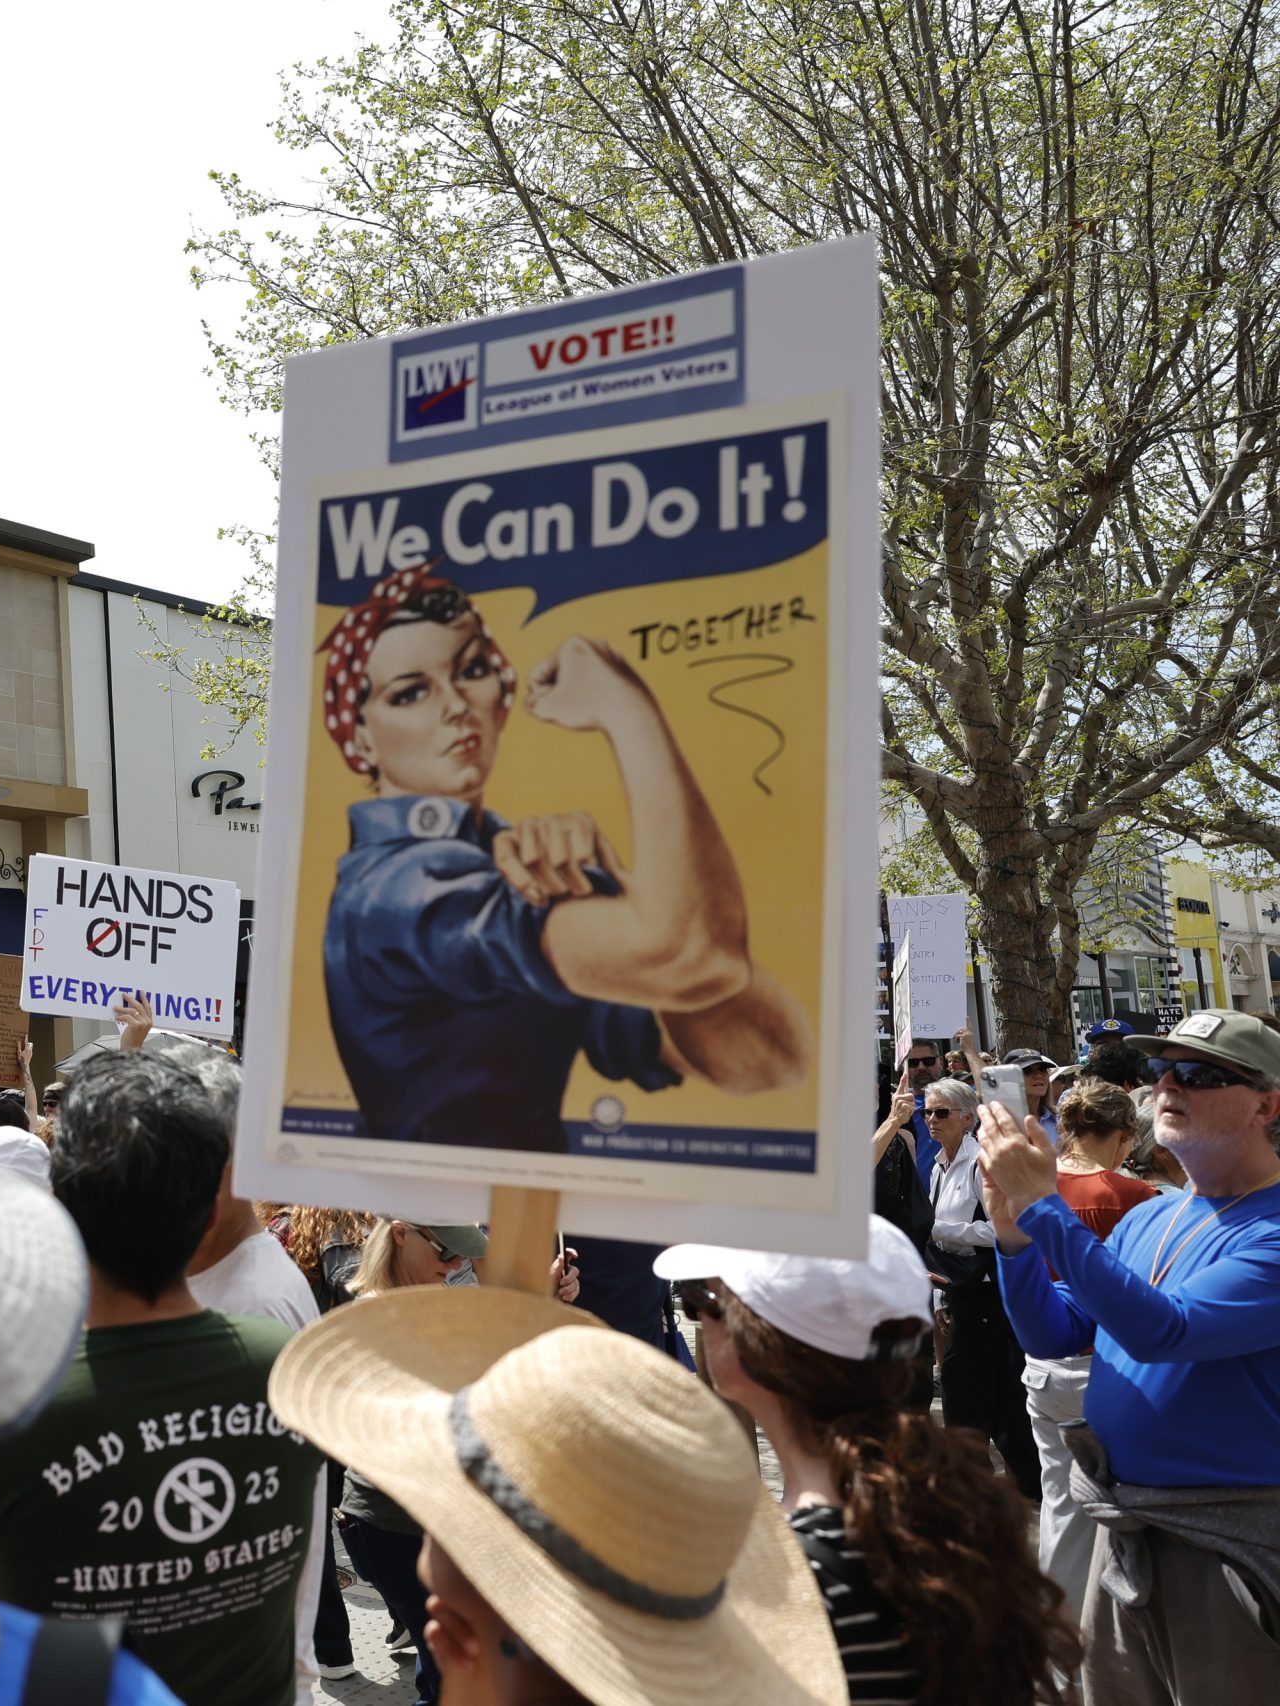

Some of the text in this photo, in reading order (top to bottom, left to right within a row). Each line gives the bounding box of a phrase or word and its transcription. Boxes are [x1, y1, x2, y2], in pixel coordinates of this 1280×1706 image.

[528, 314, 675, 373] VOTE!!
[484, 358, 729, 415] League of Women Voters
[326, 434, 808, 581] We Can Do It!
[630, 596, 816, 662] TOGETHER
[56, 866, 214, 924] HANDS
[891, 898, 949, 918] ANDS
[86, 917, 177, 965] OFF
[1156, 1024, 1175, 1033] NEV
[1157, 1008, 1181, 1016] HATE
[42, 1400, 305, 1497] BAD RELIGIO
[98, 1465, 280, 1534] 20 23
